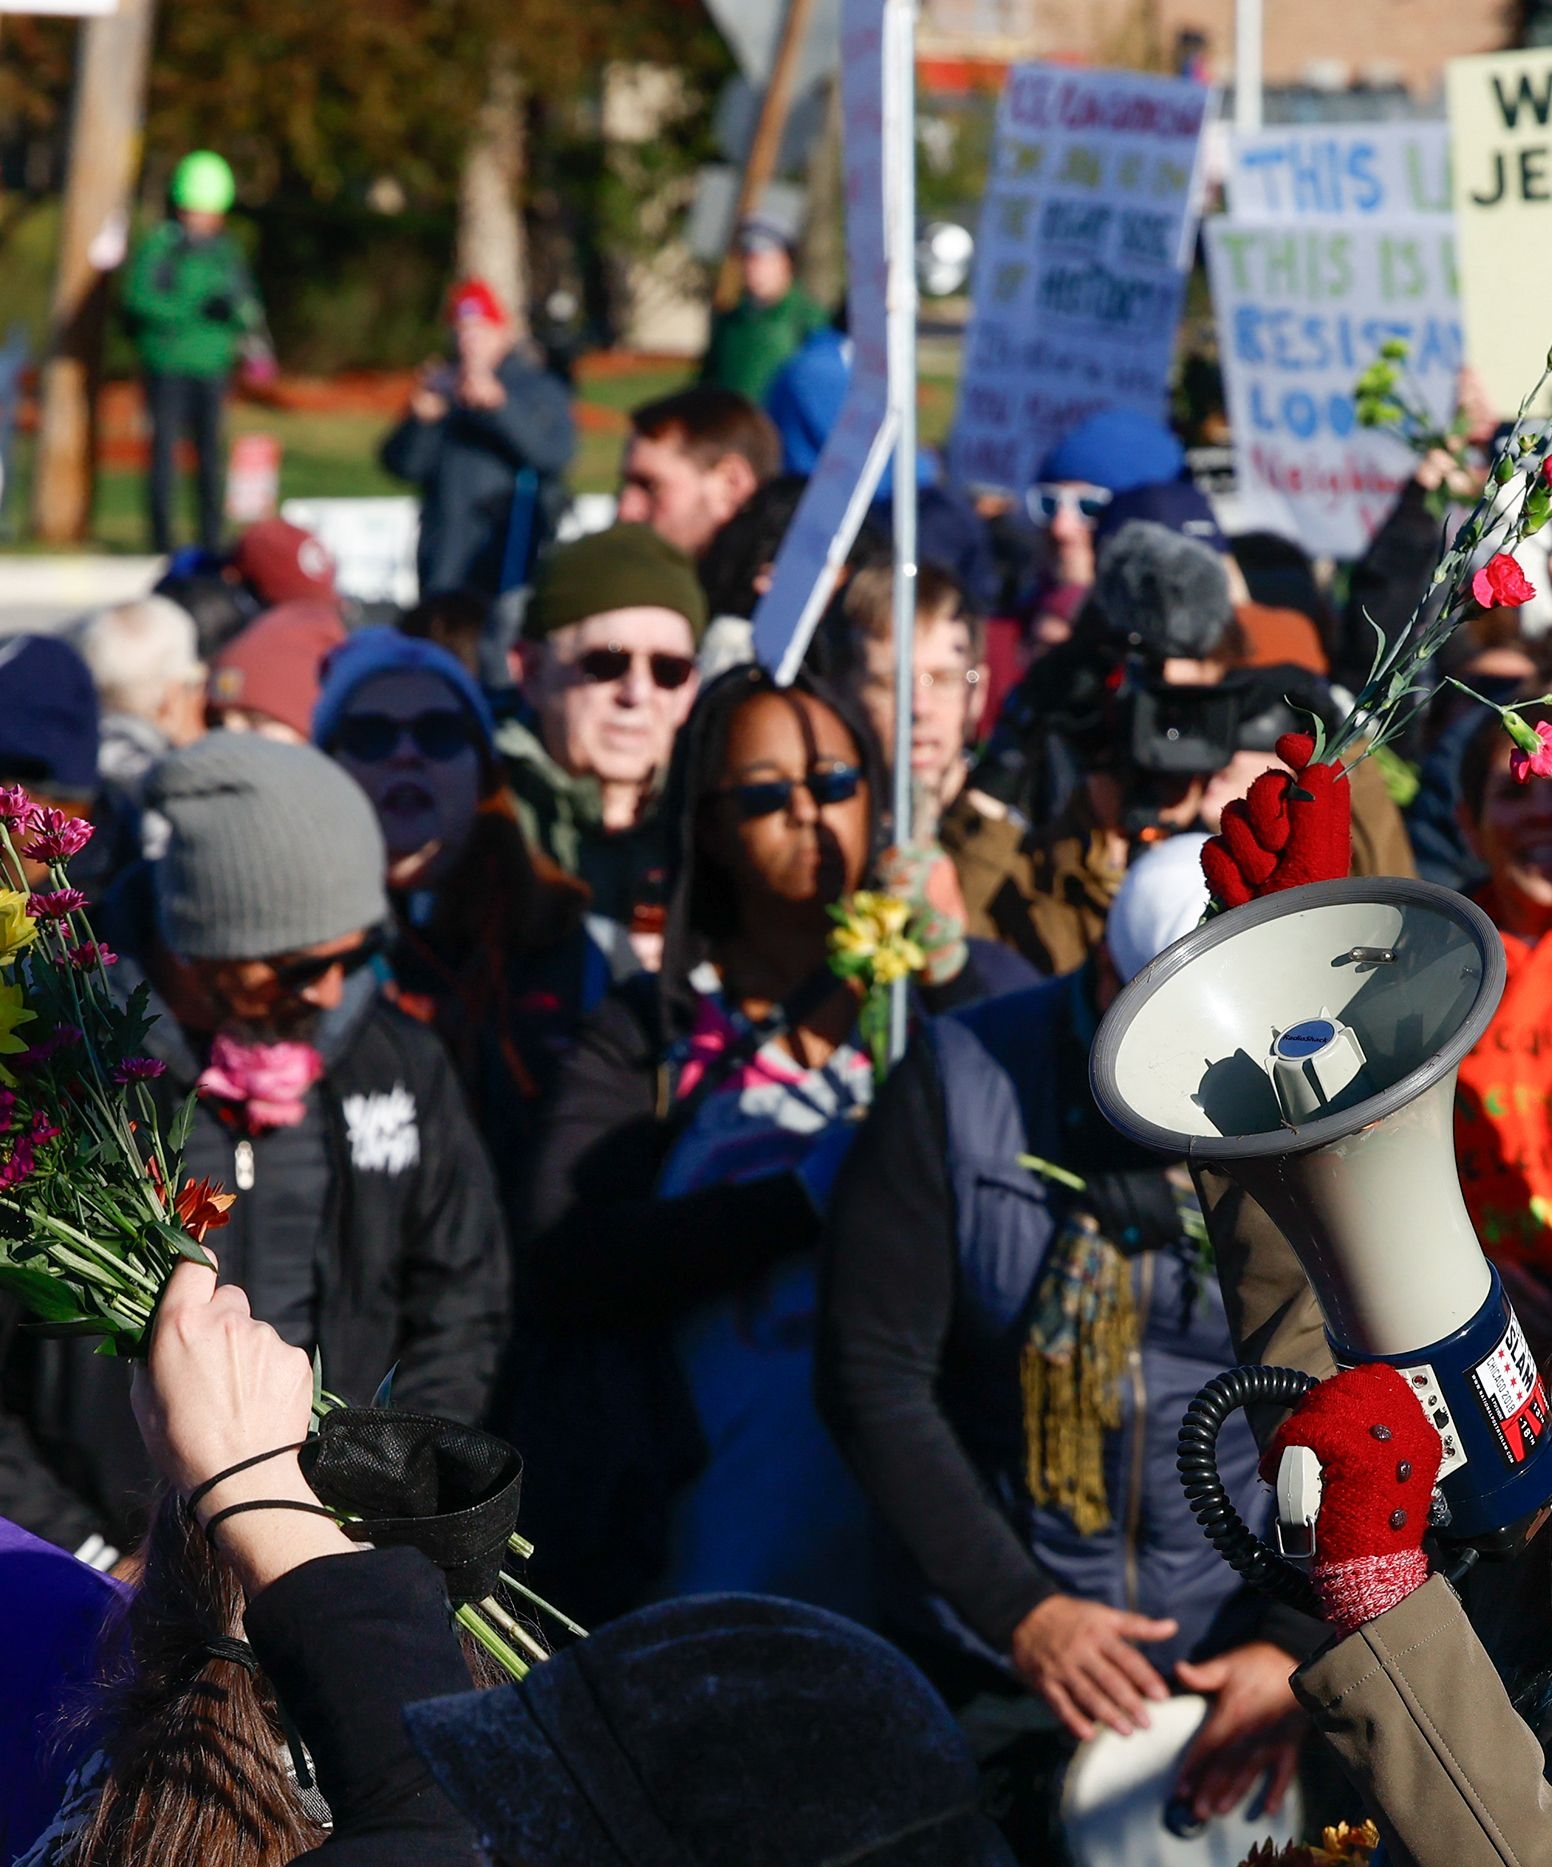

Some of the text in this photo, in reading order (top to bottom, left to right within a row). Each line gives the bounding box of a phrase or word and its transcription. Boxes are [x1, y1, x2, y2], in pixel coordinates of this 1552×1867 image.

[1241, 139, 1384, 214] THIS
[1219, 232, 1353, 298] THIS
[1377, 235, 1427, 300] IS
[1282, 1034, 1328, 1044] RadioShack
[1486, 1356, 1516, 1414] CHICAGO 2018
[1505, 1324, 1535, 1393] SLAM
